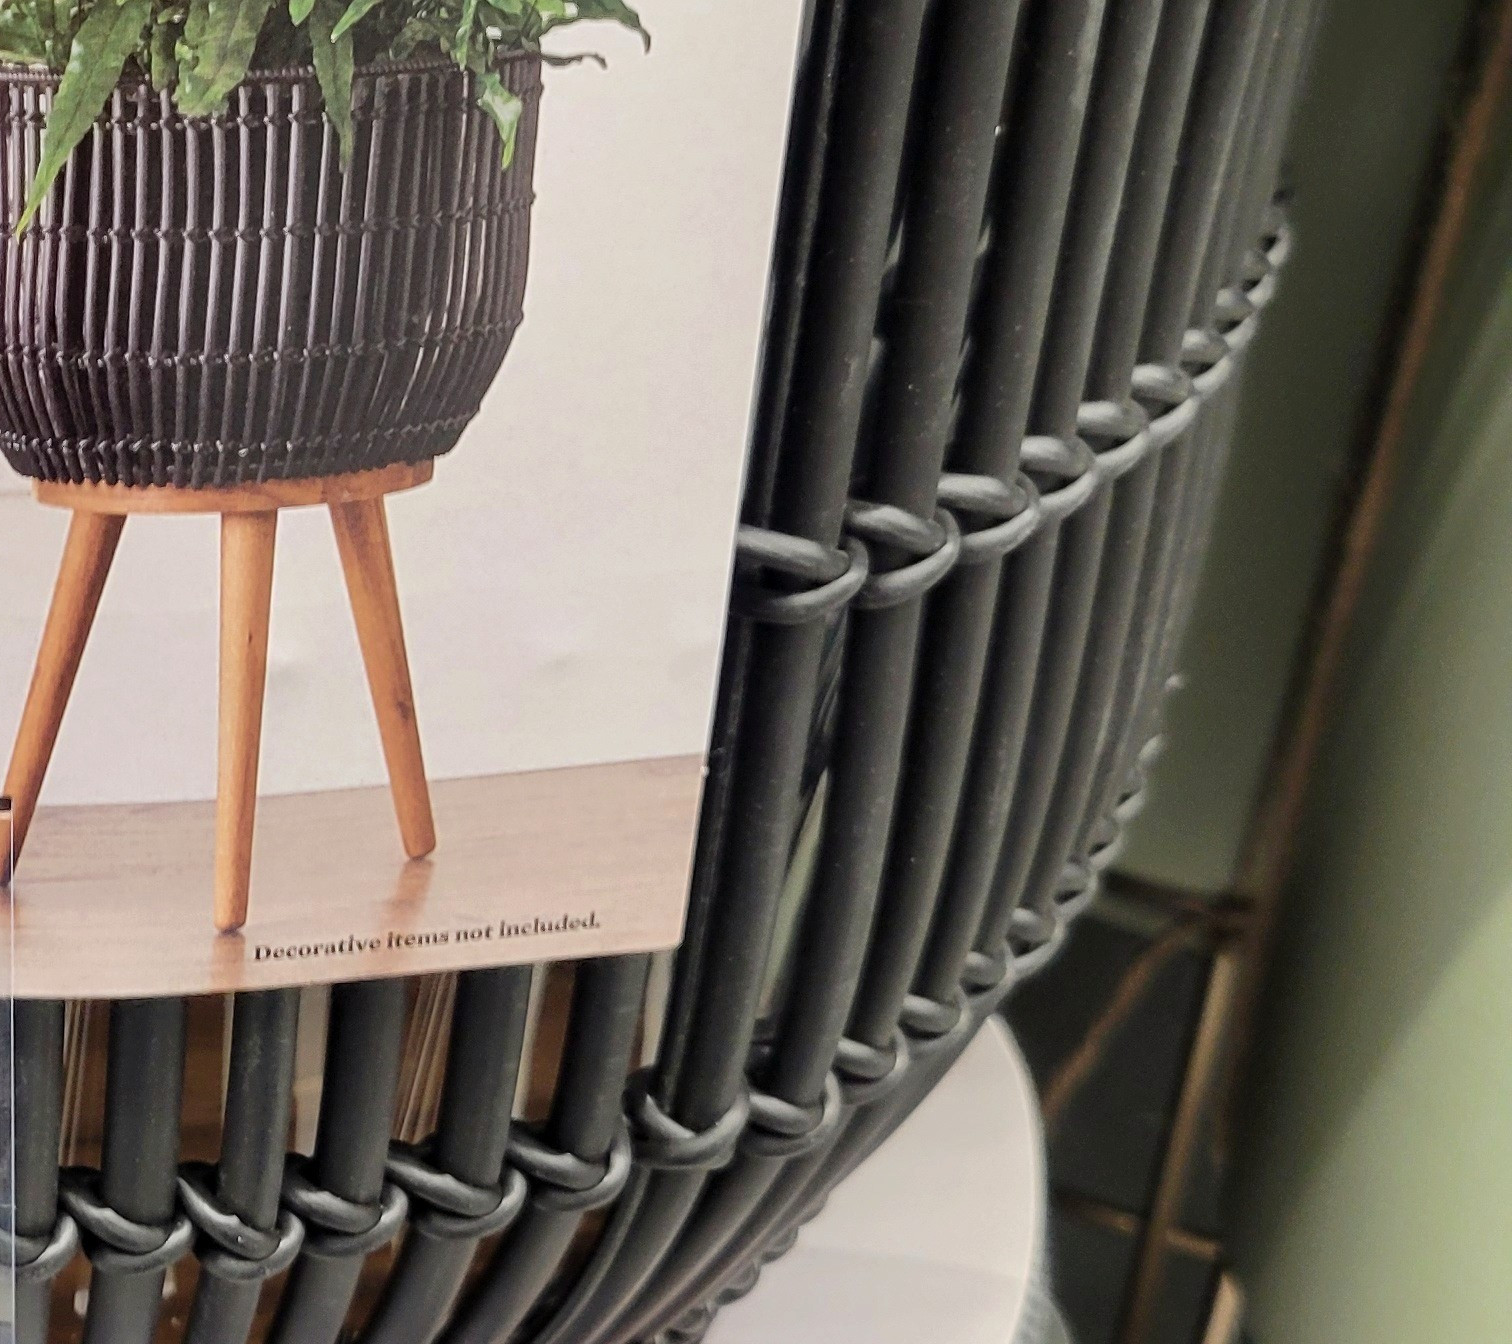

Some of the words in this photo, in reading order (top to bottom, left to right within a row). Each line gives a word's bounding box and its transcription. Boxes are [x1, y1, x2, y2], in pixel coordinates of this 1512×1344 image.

[253, 934, 381, 961] Decorative
[386, 930, 449, 949] items
[454, 925, 495, 944] not
[498, 910, 601, 939] included.
